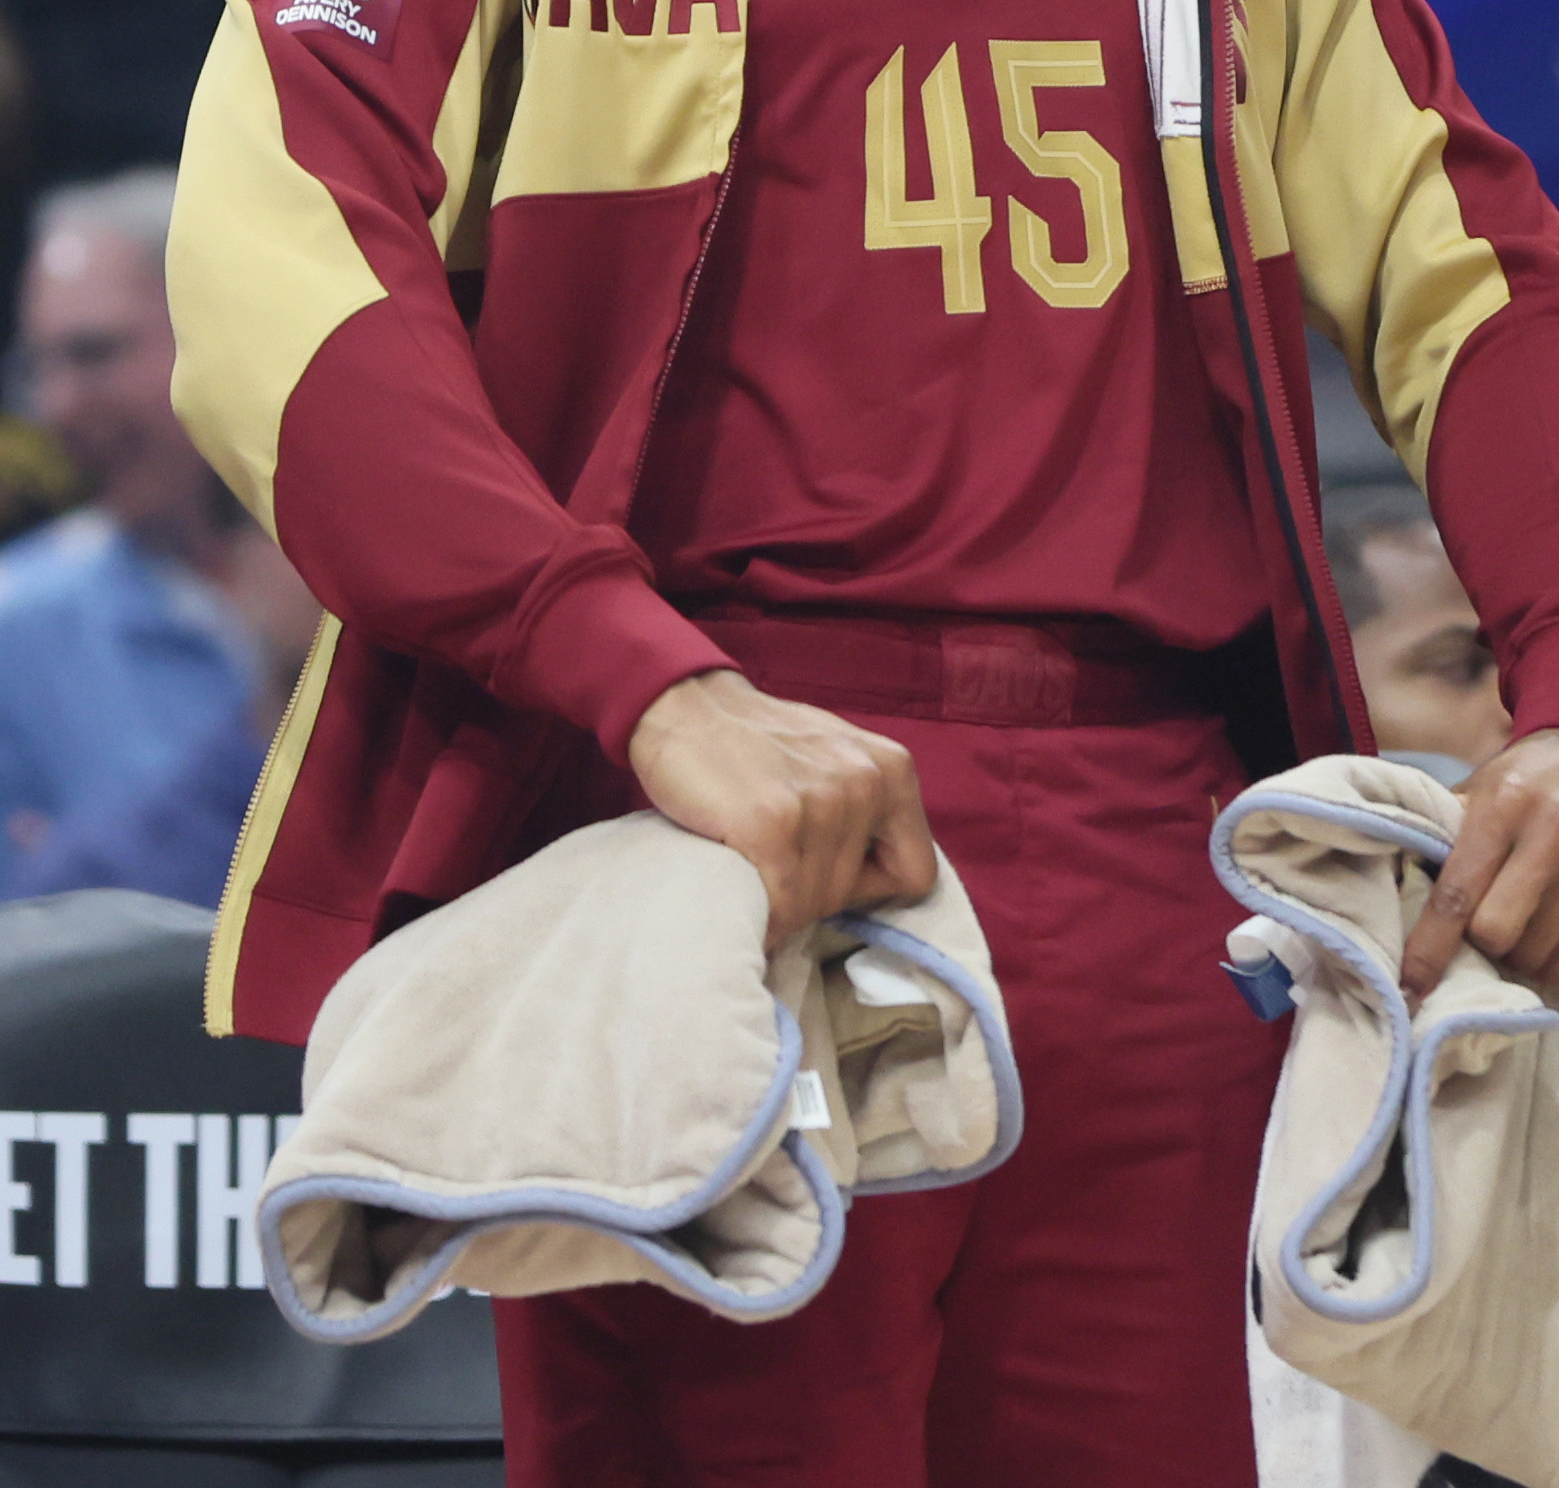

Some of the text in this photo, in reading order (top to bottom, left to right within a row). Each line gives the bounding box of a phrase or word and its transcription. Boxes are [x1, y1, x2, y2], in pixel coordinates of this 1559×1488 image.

[276, 5, 377, 44] DENNISON
[865, 40, 1130, 314] 45
[126, 1113, 304, 1289] TH
